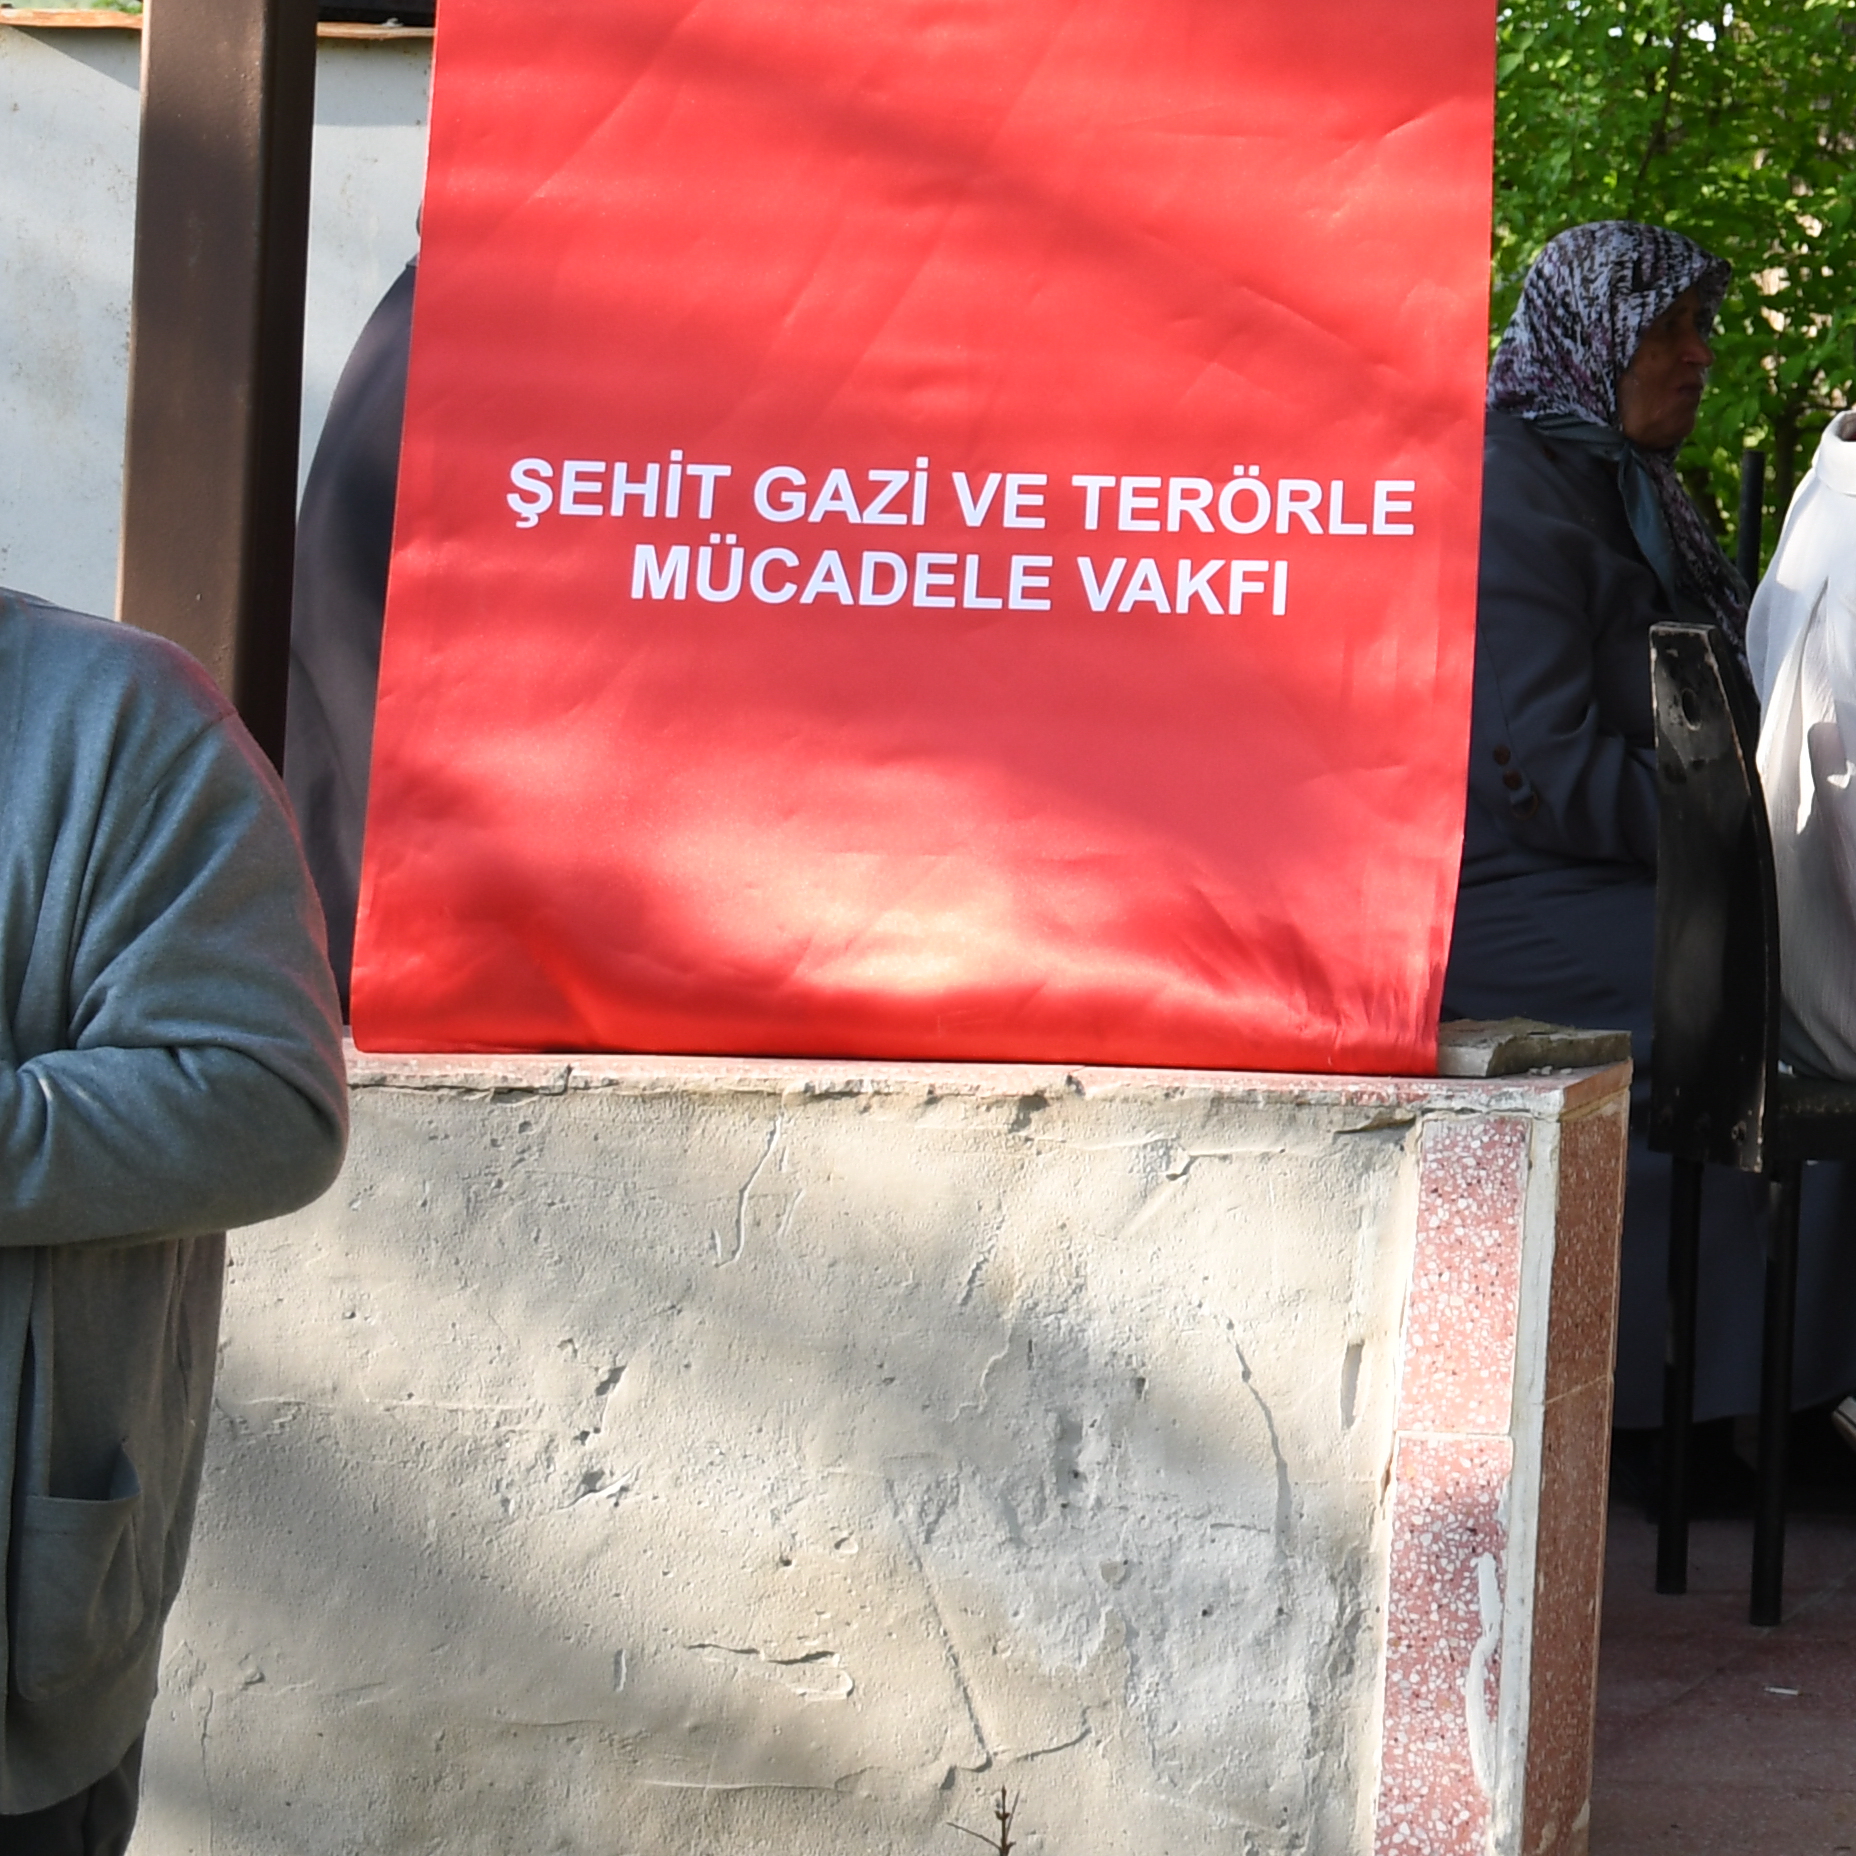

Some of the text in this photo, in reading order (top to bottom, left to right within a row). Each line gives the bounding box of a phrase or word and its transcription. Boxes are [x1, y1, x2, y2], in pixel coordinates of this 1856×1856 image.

[505, 448, 1417, 537] ŞEHİT GAZİ VE TERÖRLE
[629, 532, 1290, 617] MÜCADELE VAKFI
